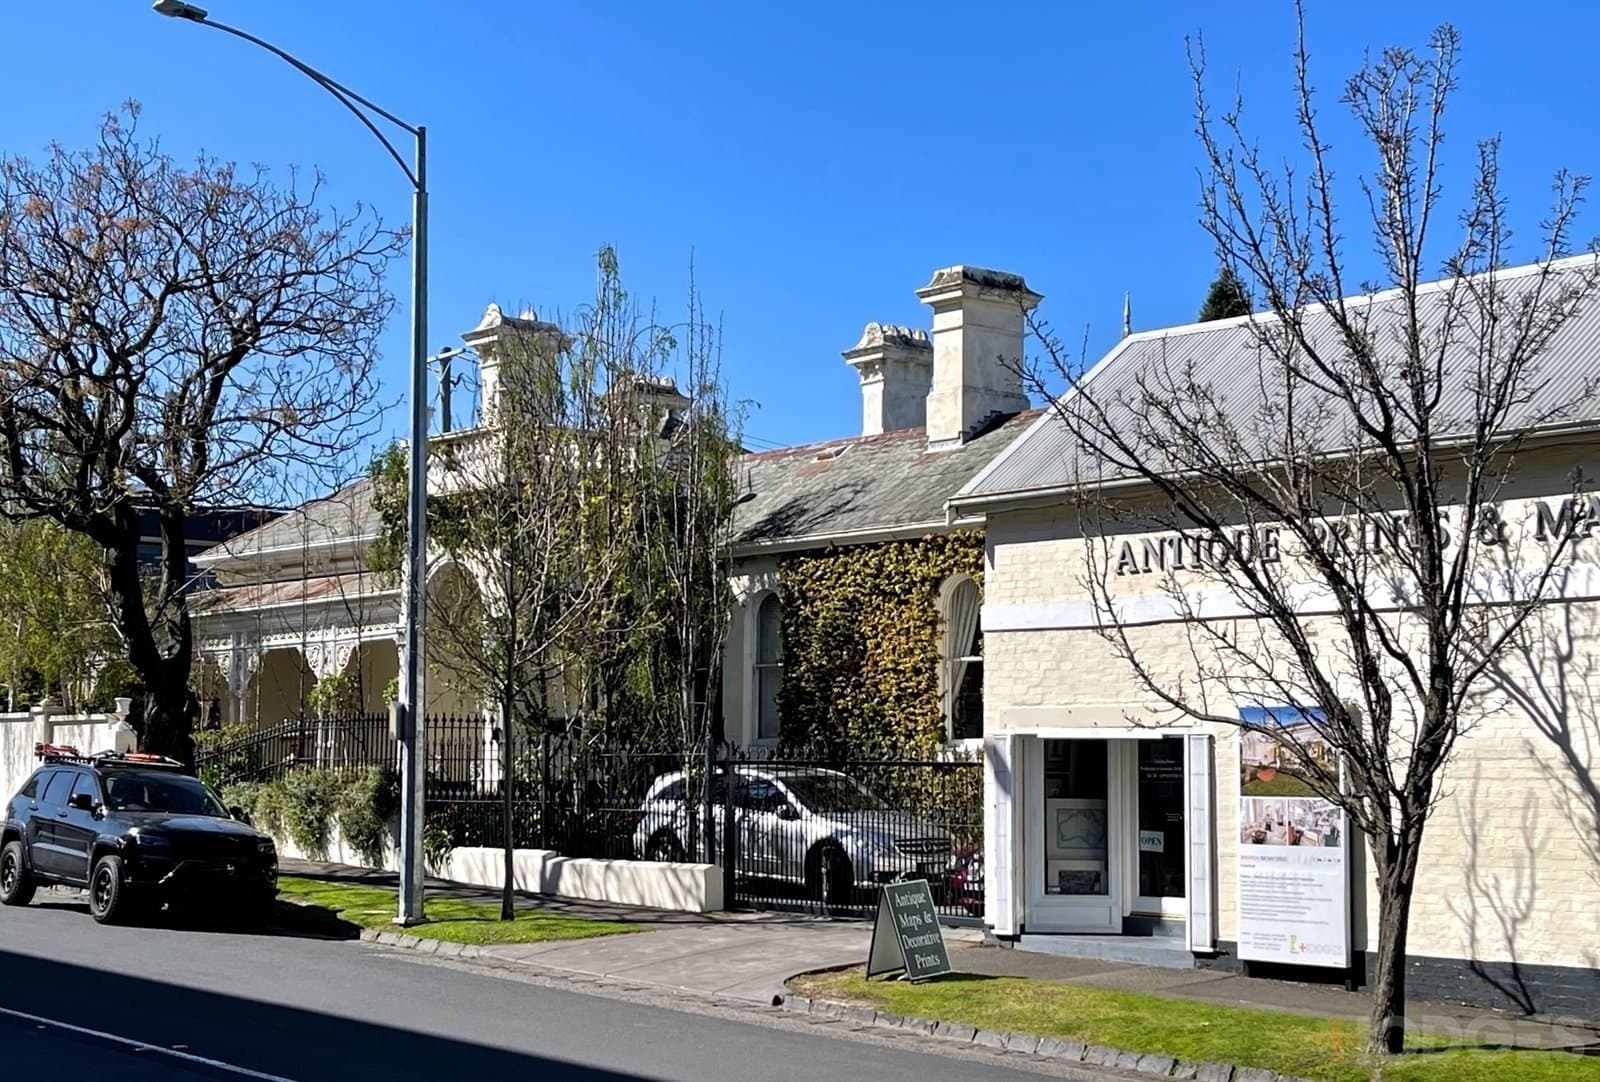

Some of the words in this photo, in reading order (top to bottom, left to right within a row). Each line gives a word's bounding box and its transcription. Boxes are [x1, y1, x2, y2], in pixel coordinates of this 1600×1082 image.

[1117, 528, 1282, 576] ANTIQUE
[1479, 502, 1508, 546] &
[894, 890, 927, 909] Antique
[899, 912, 923, 931] Maps
[923, 911, 933, 924] &
[902, 930, 942, 950] Decorative
[914, 952, 941, 969] Prints
